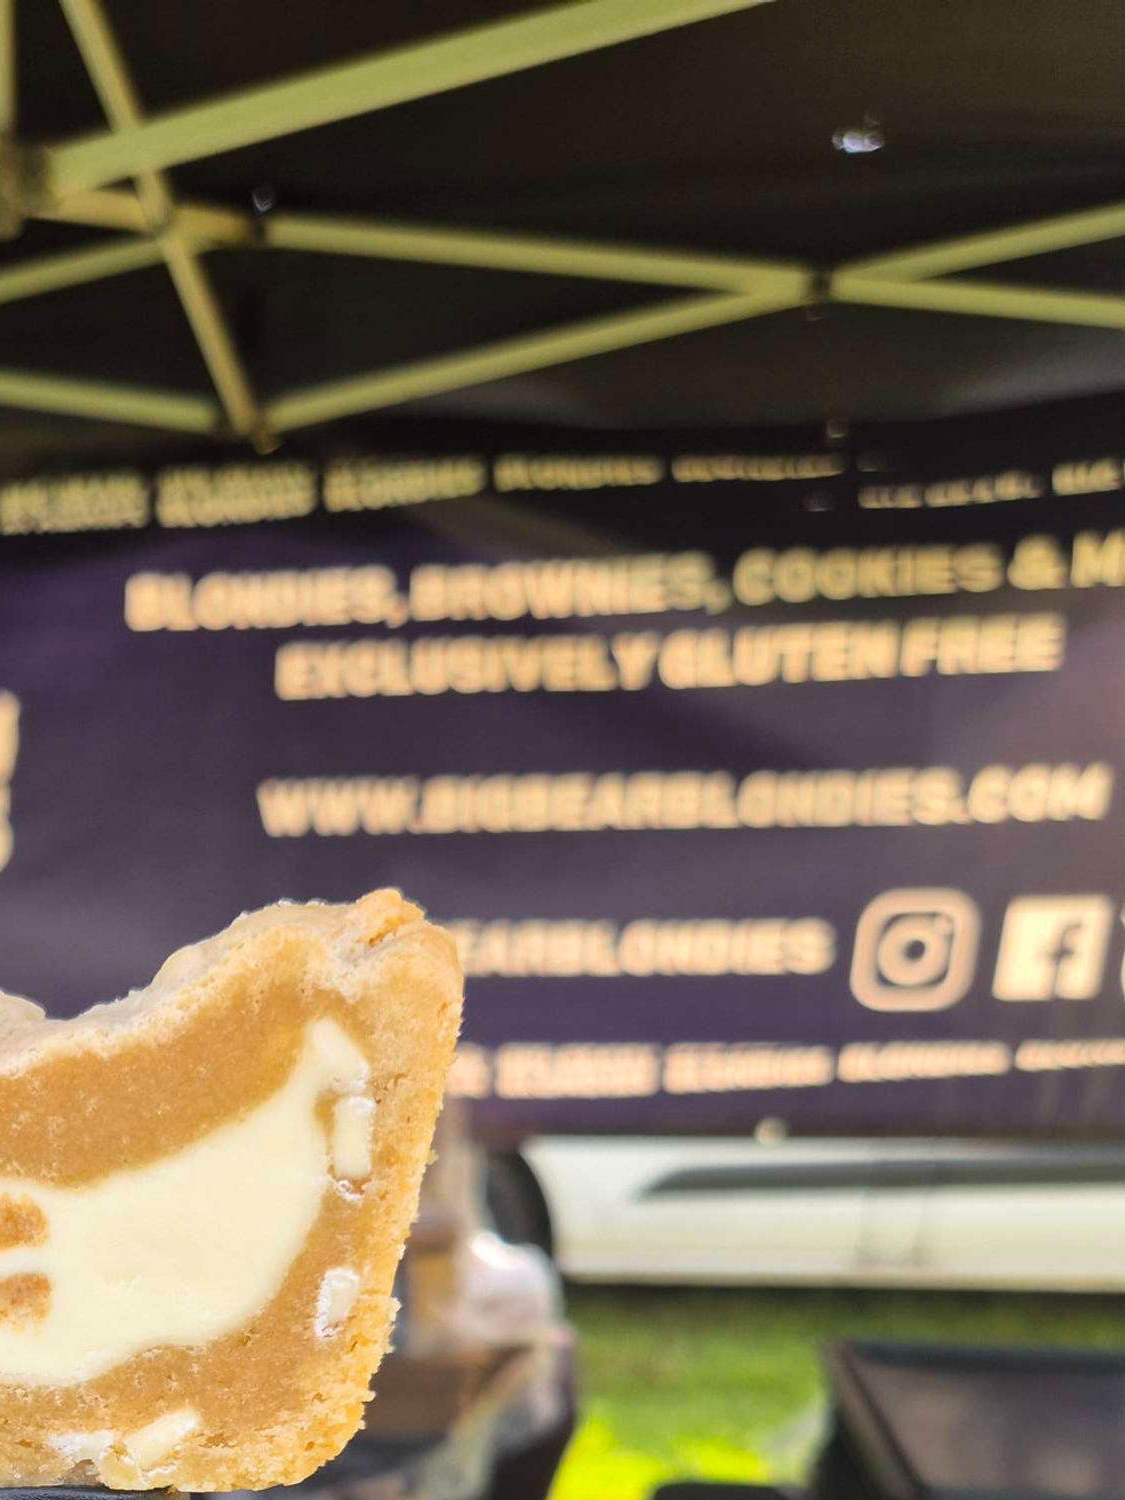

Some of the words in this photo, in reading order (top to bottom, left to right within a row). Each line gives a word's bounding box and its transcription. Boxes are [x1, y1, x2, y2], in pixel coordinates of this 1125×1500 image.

[733, 541, 1005, 607] COOKIES
[1008, 533, 1068, 591] &
[276, 630, 659, 700] EXCLUSIVELY
[658, 618, 901, 691] GLUTEN
[900, 611, 1067, 677] FREE
